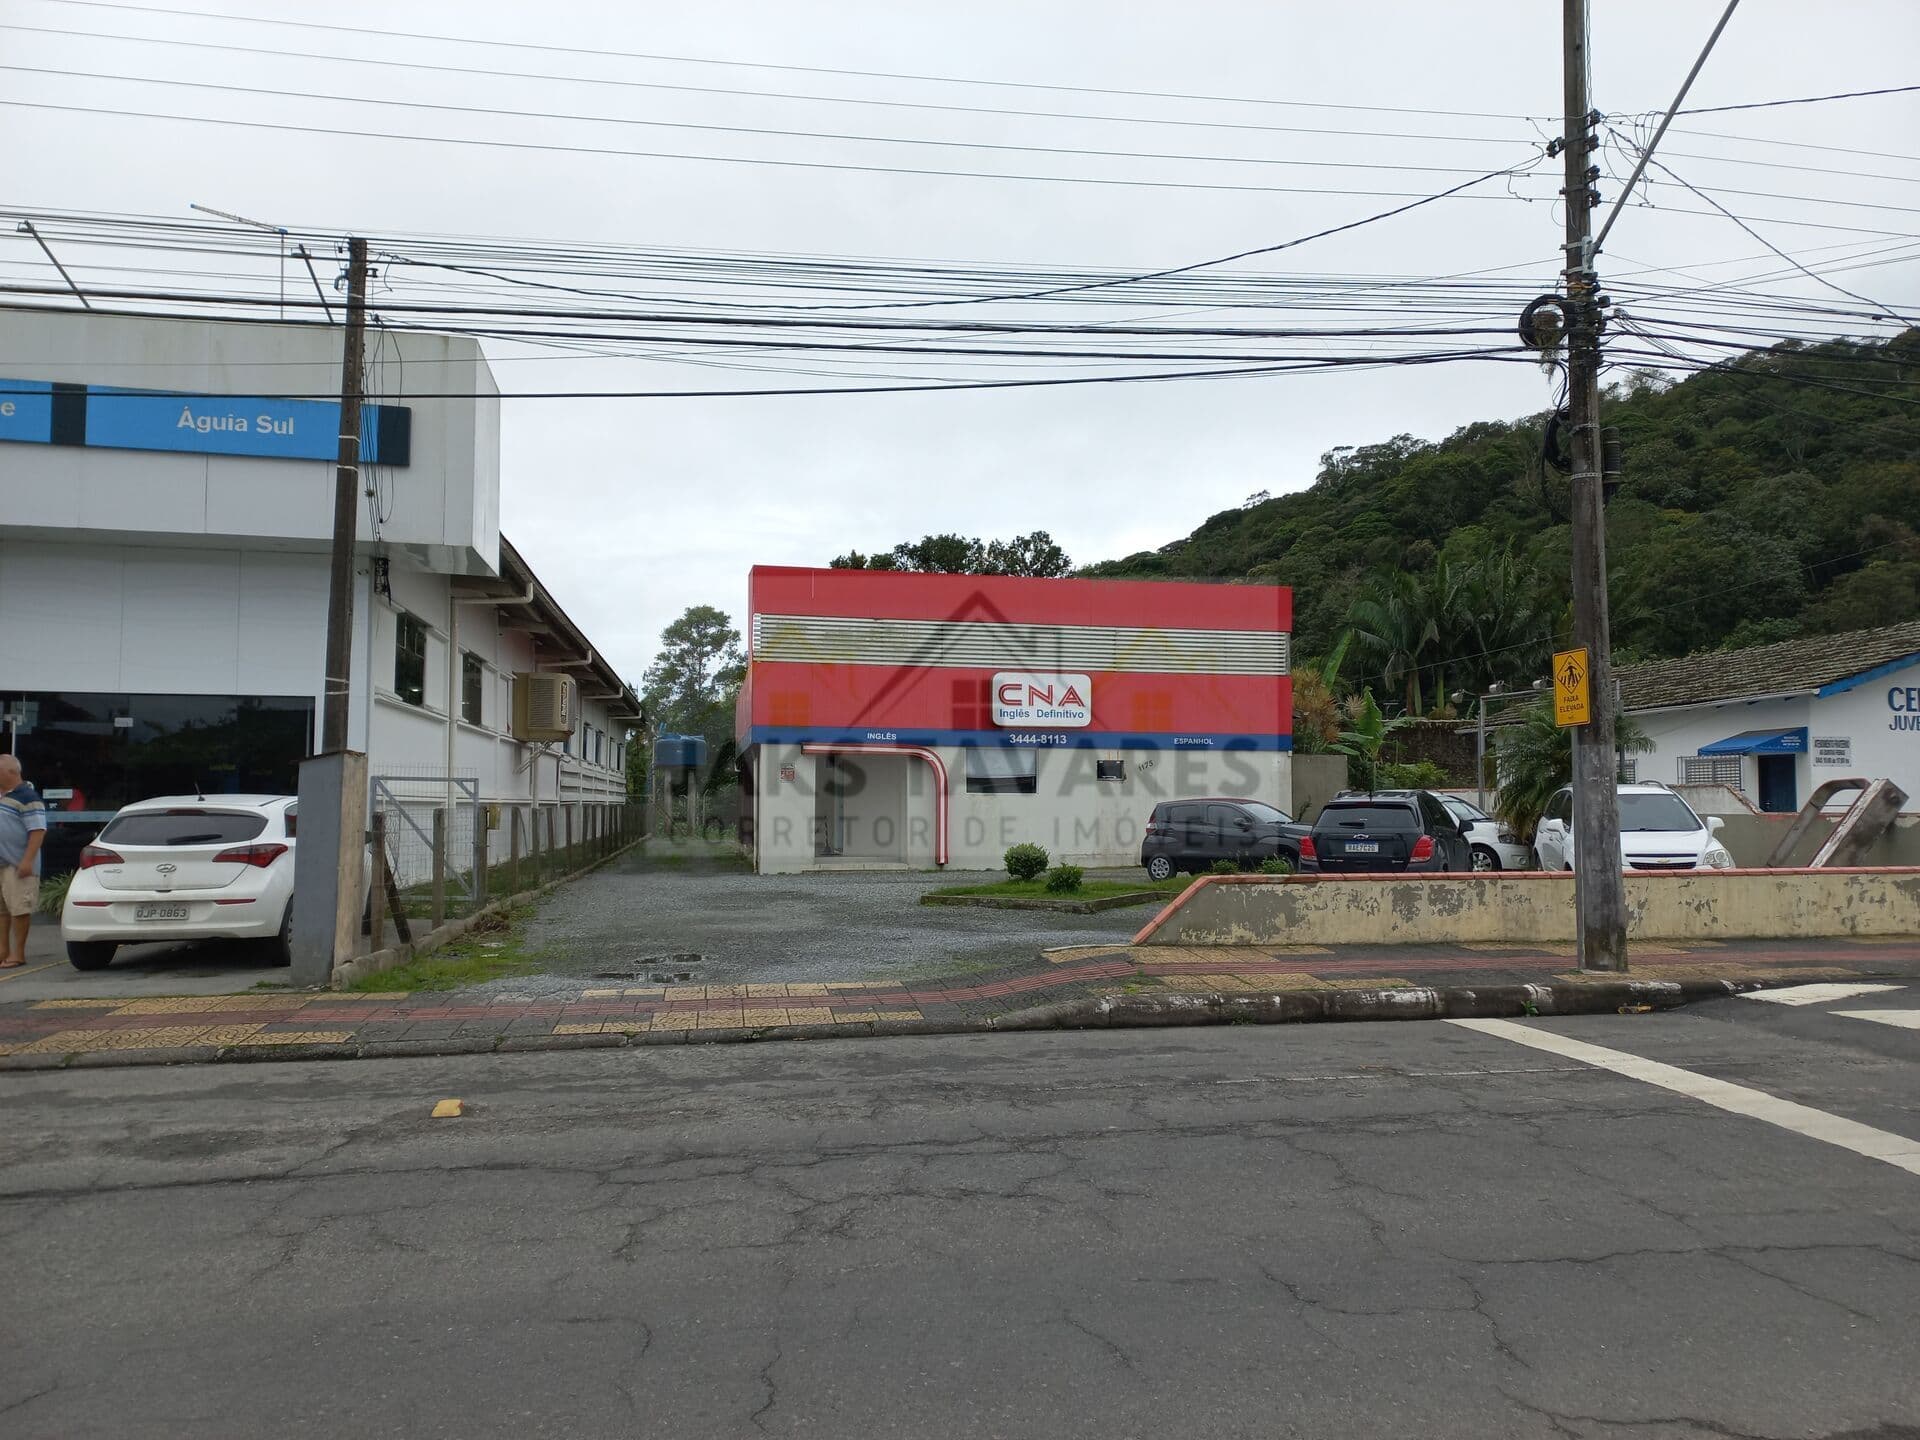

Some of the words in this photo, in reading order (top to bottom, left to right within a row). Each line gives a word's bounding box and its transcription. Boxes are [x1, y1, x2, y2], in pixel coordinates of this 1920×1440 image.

[176, 406, 248, 433] Águia
[256, 415, 294, 435] Sul
[998, 683, 1085, 707] CNA
[1888, 687, 1920, 712] CE
[1559, 703, 1585, 713] ELEVADA
[1000, 709, 1031, 720] Inglês
[1036, 709, 1085, 719] Definitivo
[867, 731, 897, 741] INGLÊS
[1009, 734, 1067, 744] 3444-8113
[1174, 737, 1214, 745] ESPANHOL
